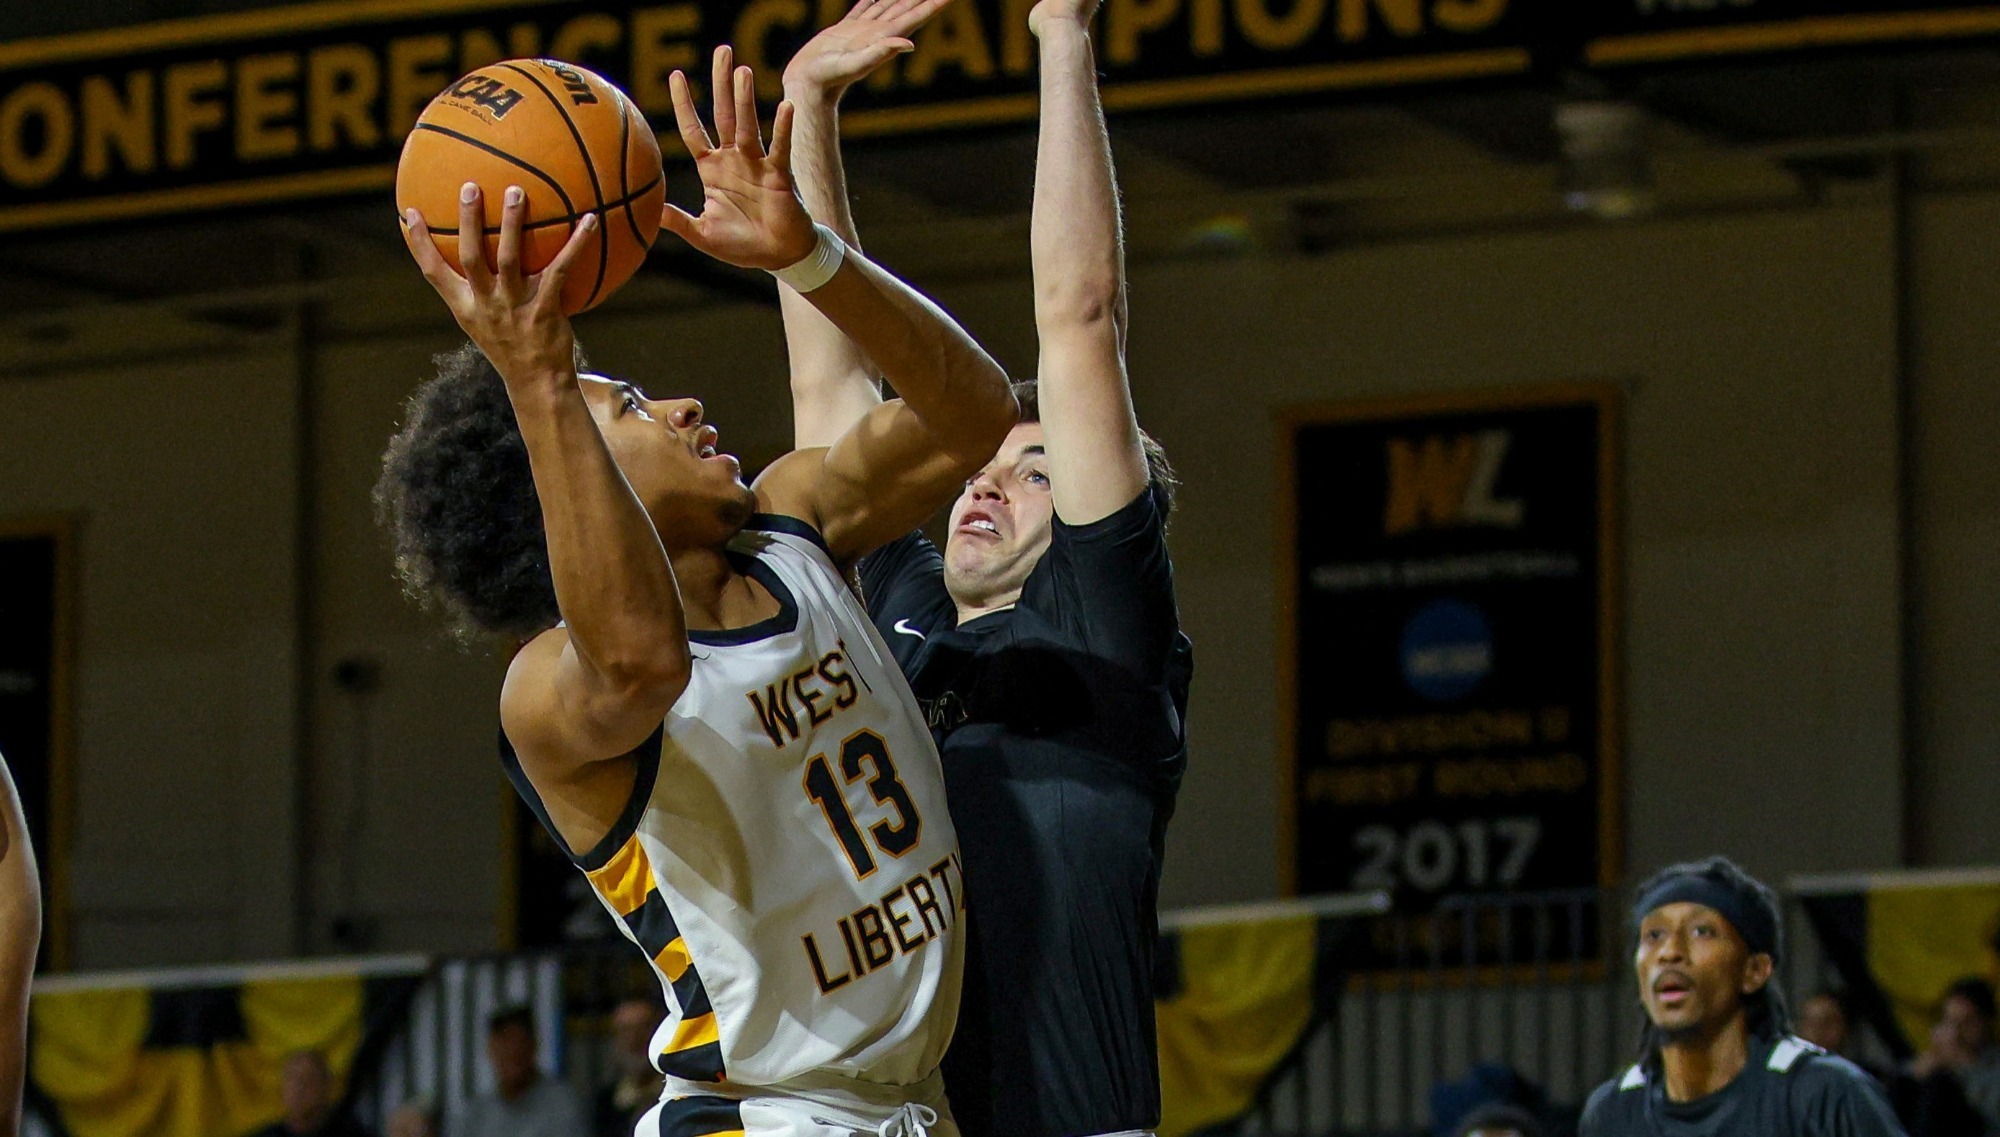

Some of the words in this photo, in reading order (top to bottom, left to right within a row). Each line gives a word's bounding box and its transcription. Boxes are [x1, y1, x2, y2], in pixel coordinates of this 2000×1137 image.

[733, 0, 1508, 104] CAPIO
[442, 75, 524, 120] CAA
[803, 727, 922, 881] 13
[1351, 818, 1540, 893] 2017
